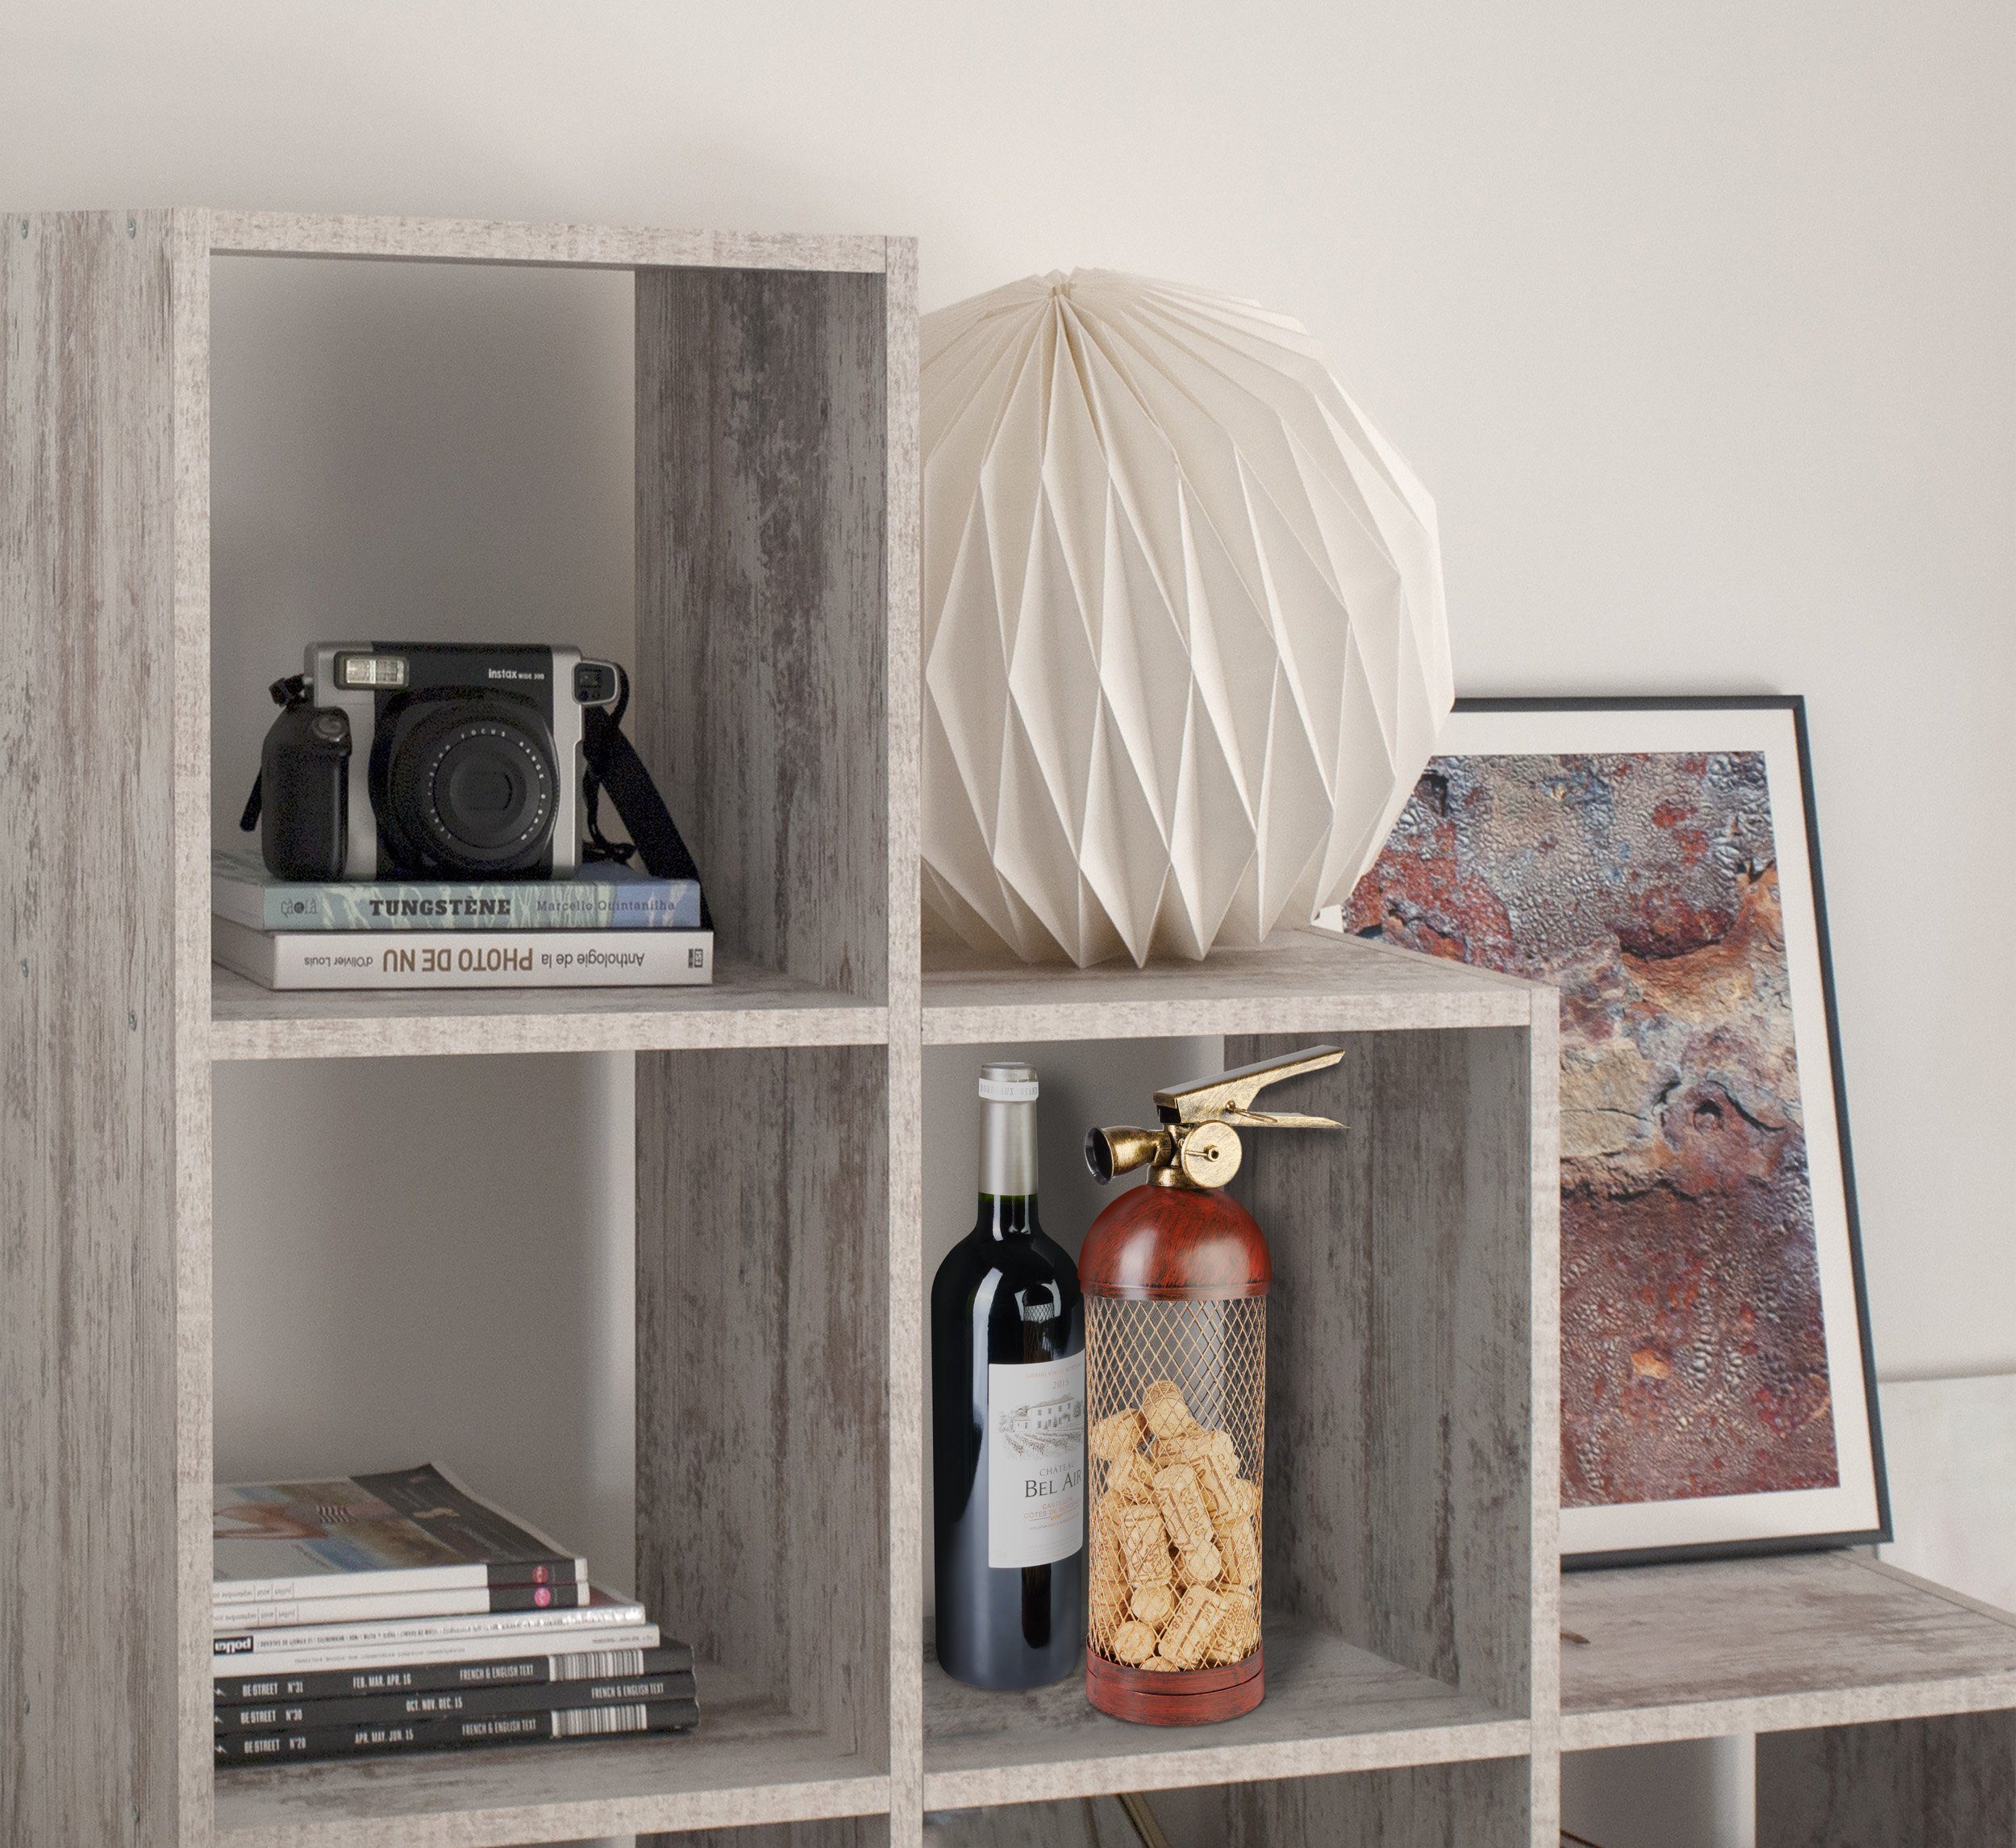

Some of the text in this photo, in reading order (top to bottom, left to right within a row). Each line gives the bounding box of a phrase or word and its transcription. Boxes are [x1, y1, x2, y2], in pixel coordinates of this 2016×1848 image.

[488, 668, 517, 679] instax
[369, 895, 511, 916] TUNGSTÈNE
[537, 900, 676, 913] Marcello Quintanilha
[304, 948, 645, 972] Anthologie de la PHOTO DE NU d'Olivier Louis
[1052, 1379, 1069, 1389] 2015
[1039, 1460, 1075, 1476] CHÂTEAU
[1025, 1480, 1057, 1498] BEL
[1042, 1497, 1073, 1510] CASTILLON
[460, 1667, 485, 1681] FRENCH
[492, 1666, 519, 1679] ENGLISH
[519, 1664, 534, 1677] TEXT
[252, 1682, 278, 1696] STREET
[591, 1686, 615, 1700] FRENCH
[623, 1684, 648, 1696] ENGLISH
[650, 1683, 664, 1695] TEXT
[455, 1696, 462, 1709] 15
[250, 1710, 276, 1724] STREET
[462, 1722, 487, 1736] FRENCH
[494, 1720, 521, 1734] ENGLISH
[522, 1718, 536, 1731] TEXT
[406, 1728, 414, 1741] 15
[254, 1738, 280, 1753] STREET
